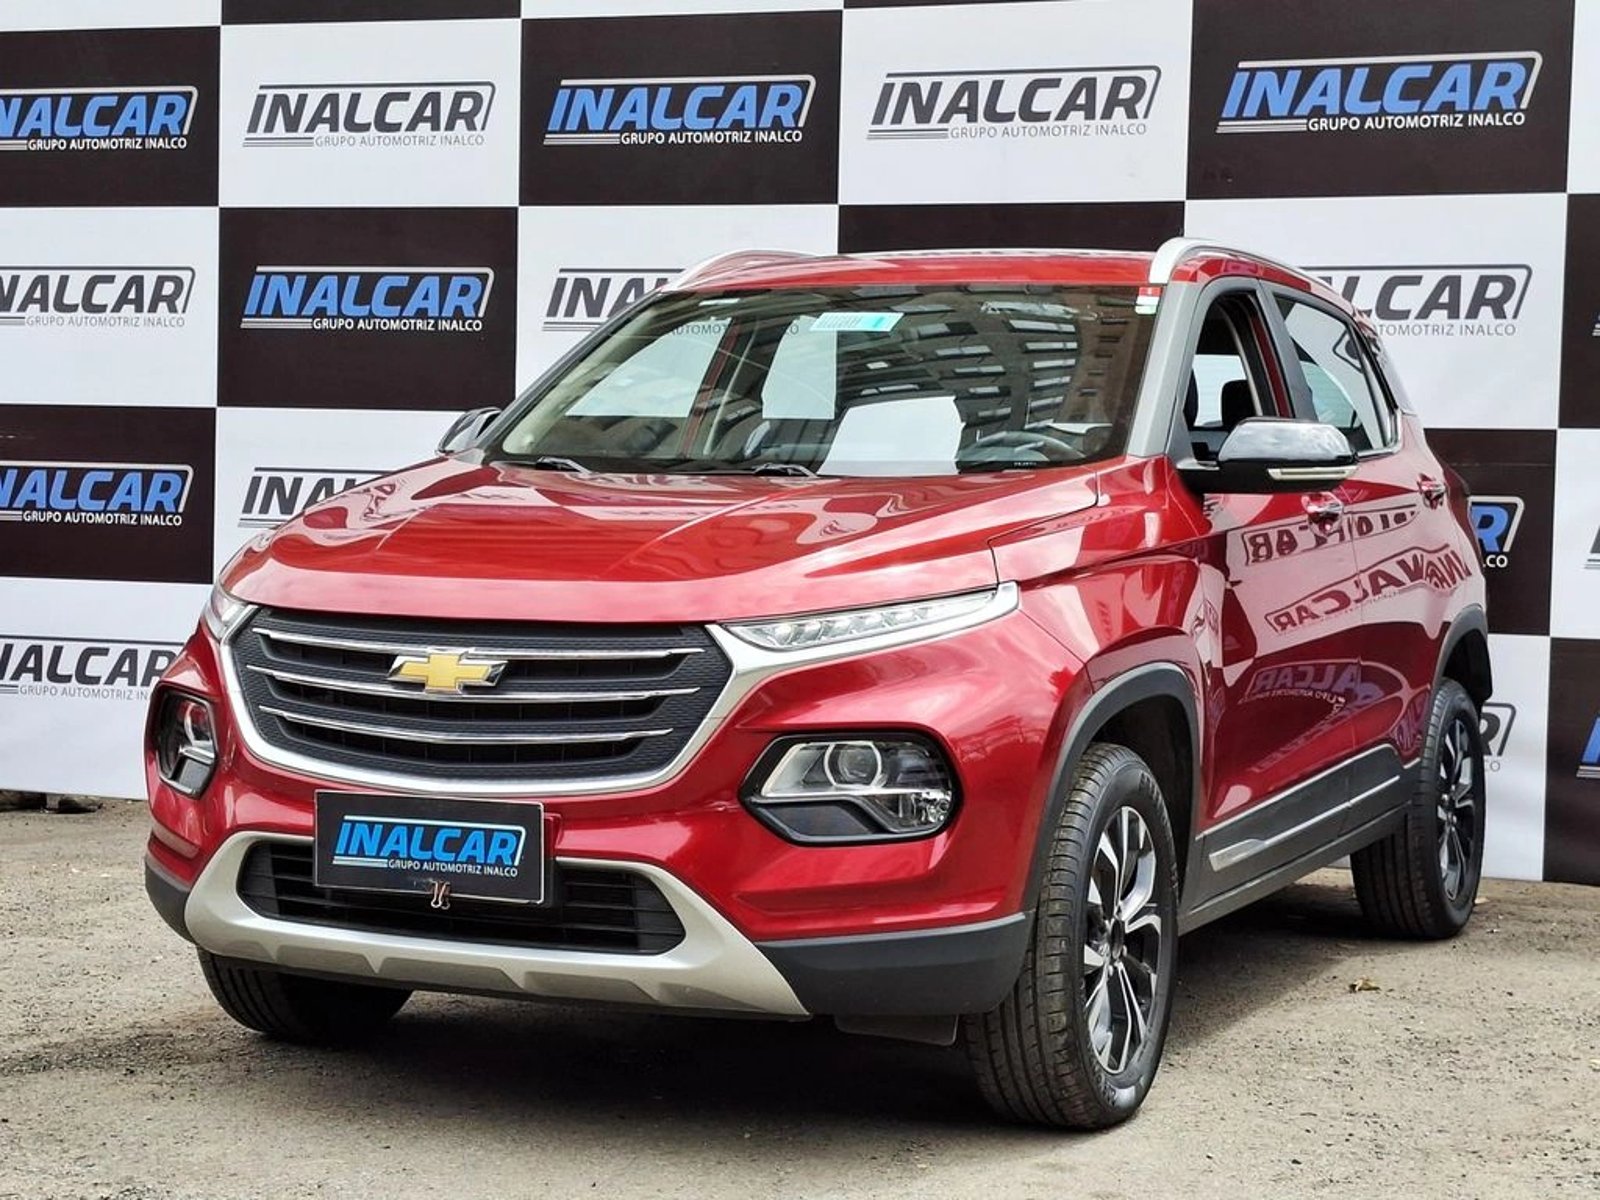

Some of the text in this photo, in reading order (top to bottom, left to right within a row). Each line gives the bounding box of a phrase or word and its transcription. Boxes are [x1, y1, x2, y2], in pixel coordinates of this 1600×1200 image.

[1222, 62, 1527, 118] INALCAR
[547, 84, 806, 131] INALCAR
[871, 76, 1147, 125] INALCAR
[0, 94, 188, 138] NALCAR
[247, 91, 485, 133] INALCAR
[1308, 112, 1525, 132] GRUPO AUTOMOTRIZ INALCO
[315, 134, 485, 147] GRUPO AUTOMOTRIZ INALCO
[621, 130, 803, 145] GRUPO AUTOMOTRIZ INALCO
[950, 123, 1147, 139] GRUPO AUTOMOTRIZ INALCO
[28, 137, 187, 151] GRUPO AUTOMOTRIZ INALCO
[0, 274, 186, 314] NALCAR
[243, 274, 483, 318] INALCAR
[26, 315, 186, 328] GRUPO AUTOMOTRIZ INALCO
[312, 318, 483, 332] GRUPO AUTOMOTRIZ INALCO
[1375, 324, 1516, 336] TOMOTRIZ INALCO
[0, 468, 183, 513] NALCAR
[23, 511, 183, 526] GRUPO AUTOMOTRIZ INALCO
[20, 685, 58, 696] GRUPO
[60, 687, 134, 700] AUTOMOTRIZ
[335, 822, 518, 865] INALCAR
[388, 858, 518, 878] GRUPO AUTOMOTRIZ INALCO
